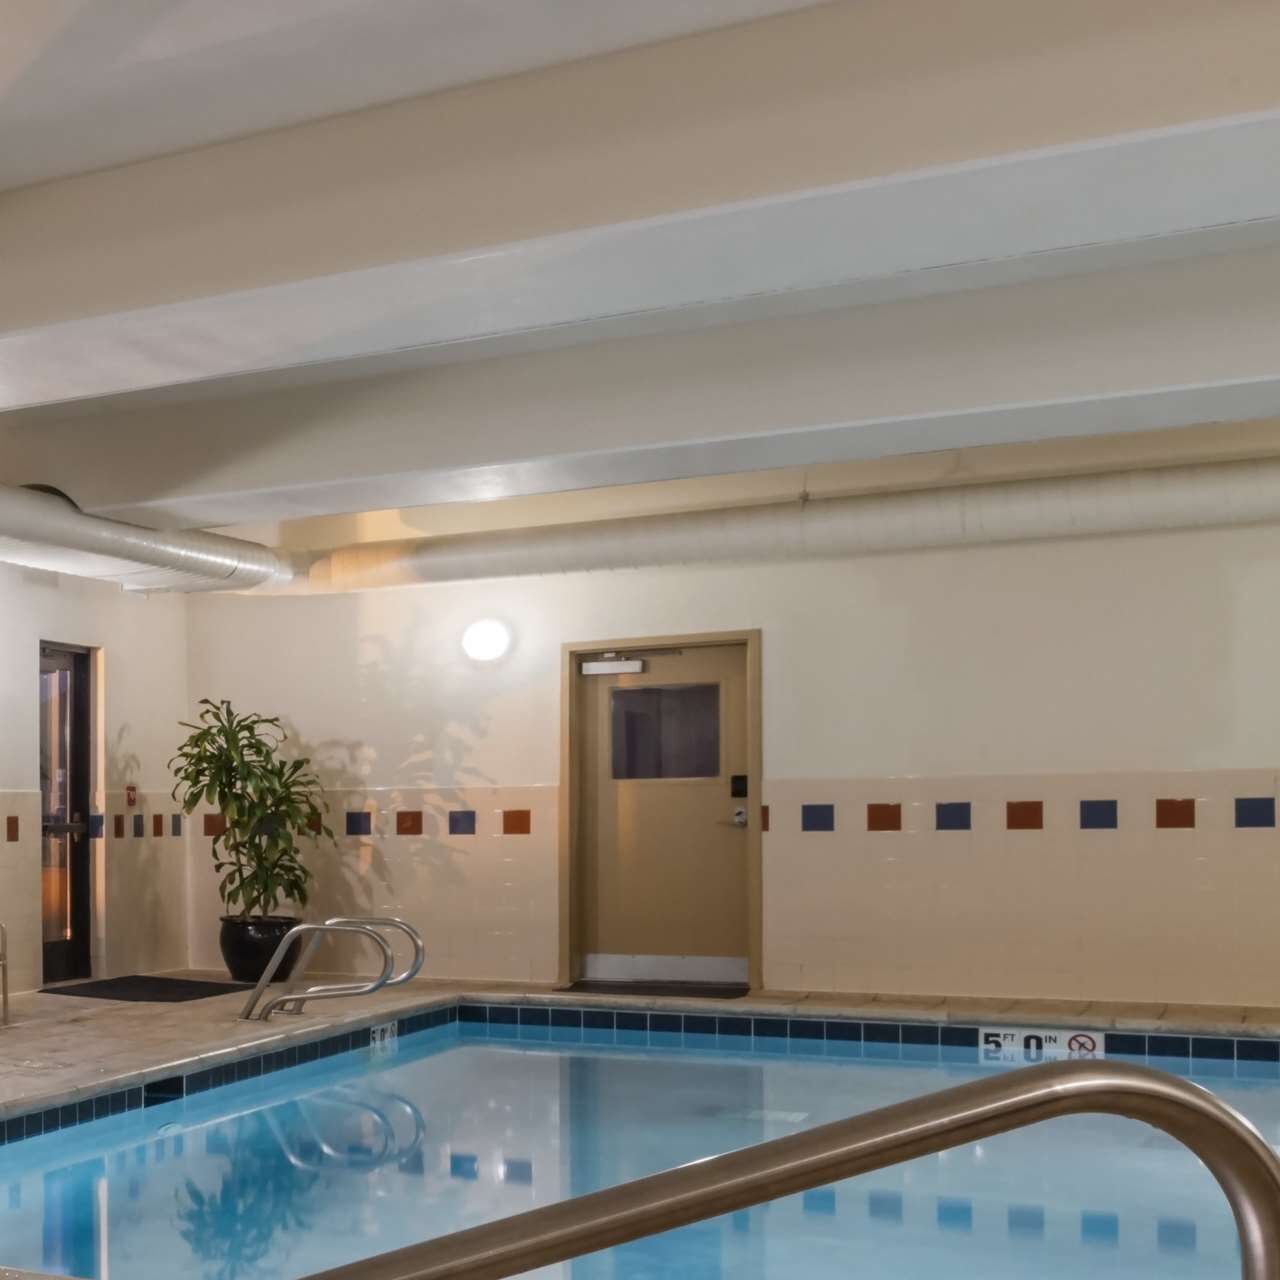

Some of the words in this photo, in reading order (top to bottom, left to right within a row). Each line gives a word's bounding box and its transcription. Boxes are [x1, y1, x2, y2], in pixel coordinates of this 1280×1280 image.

[984, 1032, 1002, 1050] 5
[1003, 1034, 1016, 1042] FT
[1024, 1034, 1043, 1051] 0
[1045, 1035, 1057, 1044] IN
